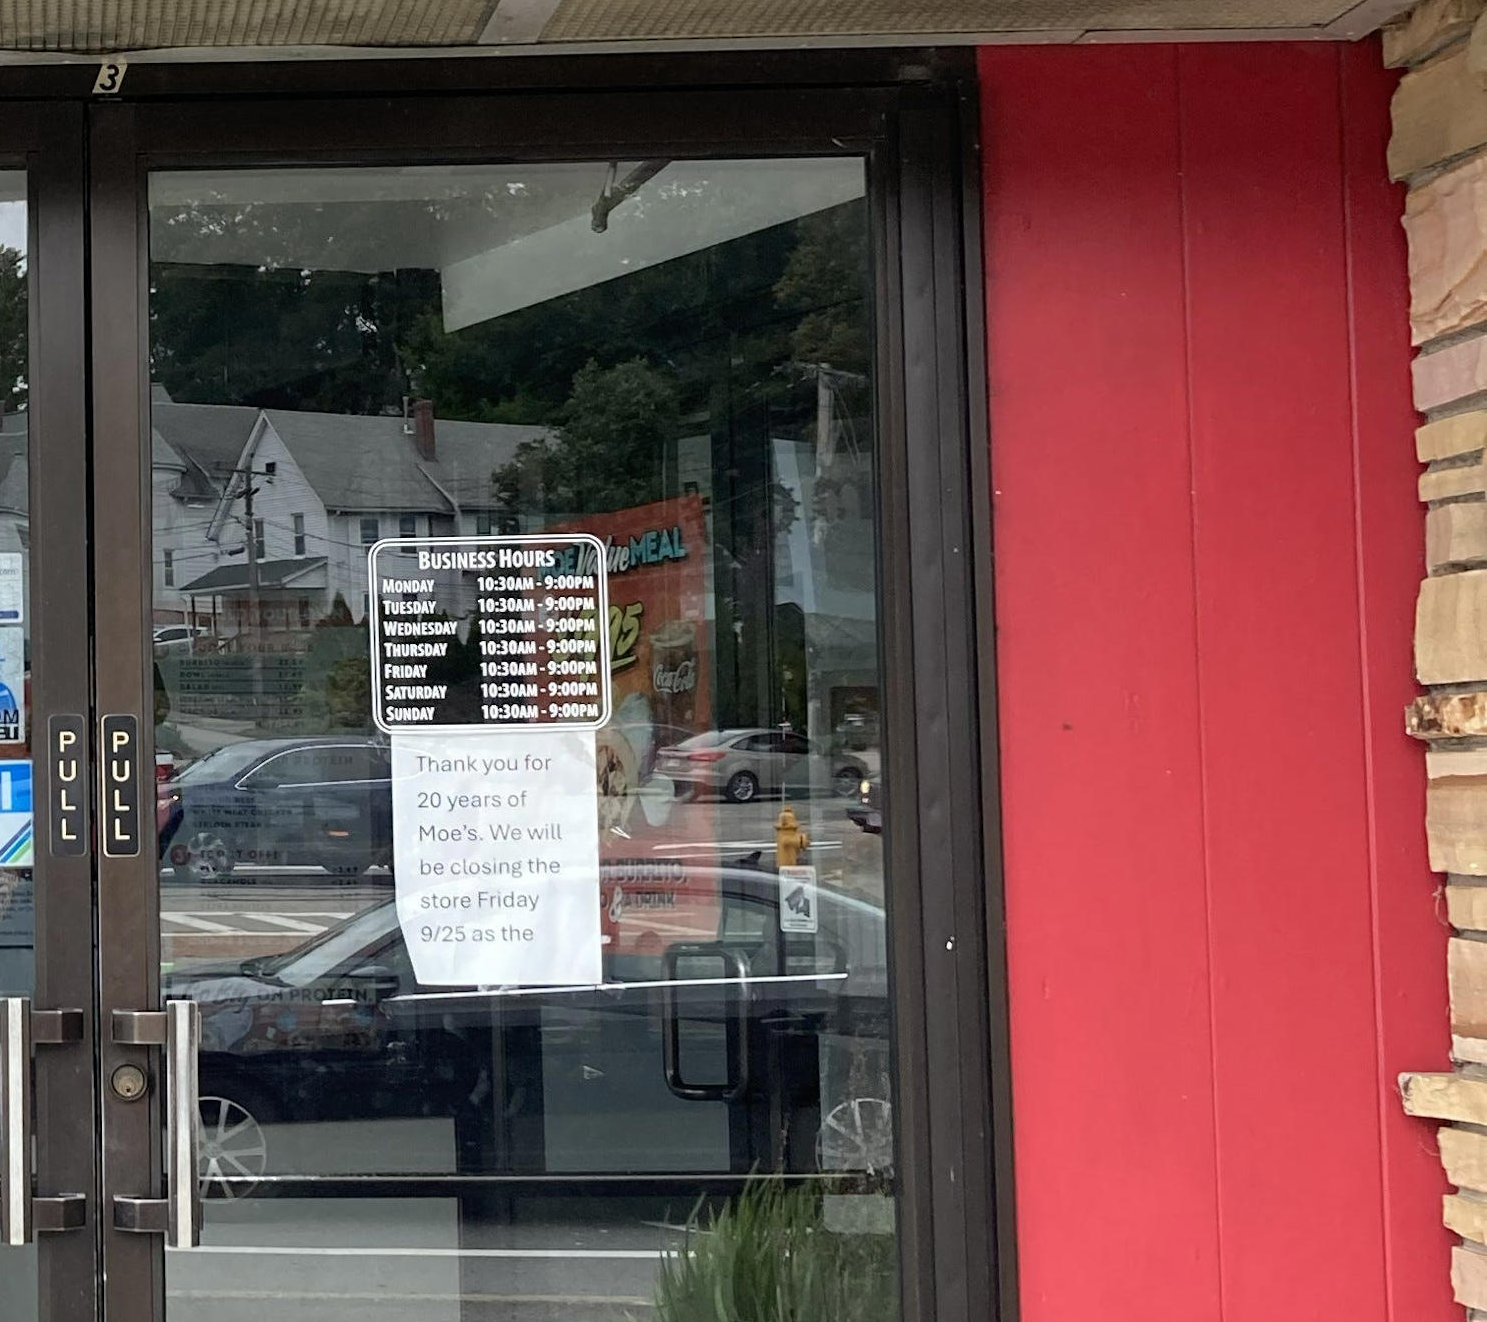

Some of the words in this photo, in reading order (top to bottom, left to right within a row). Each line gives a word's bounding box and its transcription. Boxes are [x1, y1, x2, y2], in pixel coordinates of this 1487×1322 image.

[99, 64, 119, 91] 3
[629, 526, 687, 566] MEAL
[418, 550, 496, 569] BUSINESS
[499, 550, 555, 568] HOURS
[382, 579, 434, 593] MONDAY
[477, 577, 534, 591] 10:30AM
[544, 576, 594, 589] 9:00PM
[383, 600, 436, 615] TUESDAY
[478, 598, 534, 612] 10:30AM
[545, 597, 595, 610] 9:00PM
[384, 622, 457, 636] WEDNESDAY
[478, 620, 535, 633] 10:30AM
[546, 618, 595, 632] 9:00PM
[384, 643, 448, 657] THURSDAY
[479, 641, 536, 655] 10:30AM
[547, 640, 596, 653] 9:00PM
[385, 664, 427, 679] FRIDAY
[480, 662, 537, 676] 10:30AM
[548, 661, 597, 675] 9:00PM
[385, 685, 447, 700] SATURDAY
[481, 683, 537, 697] 10:30AM
[548, 682, 598, 696] 9:00PM
[386, 707, 435, 721] SUNDAY
[482, 705, 538, 719] 10:30AM
[549, 704, 599, 717] 9:00PM
[417, 756, 477, 773] Thank
[483, 759, 518, 775] you
[525, 755, 552, 771] for
[59, 731, 77, 840] PULL
[112, 731, 131, 840] PULL
[417, 792, 441, 808] 20
[447, 795, 501, 811] years
[507, 791, 527, 808] of
[419, 825, 483, 841] Moe's.
[490, 825, 521, 840] We
[528, 824, 562, 840] will
[420, 859, 444, 875] be
[451, 860, 523, 877] closing
[528, 858, 560, 874] the
[421, 893, 471, 909] store
[478, 892, 539, 914] Friday
[421, 926, 466, 942] 9/25
[472, 928, 495, 941] as
[502, 925, 534, 941] the
